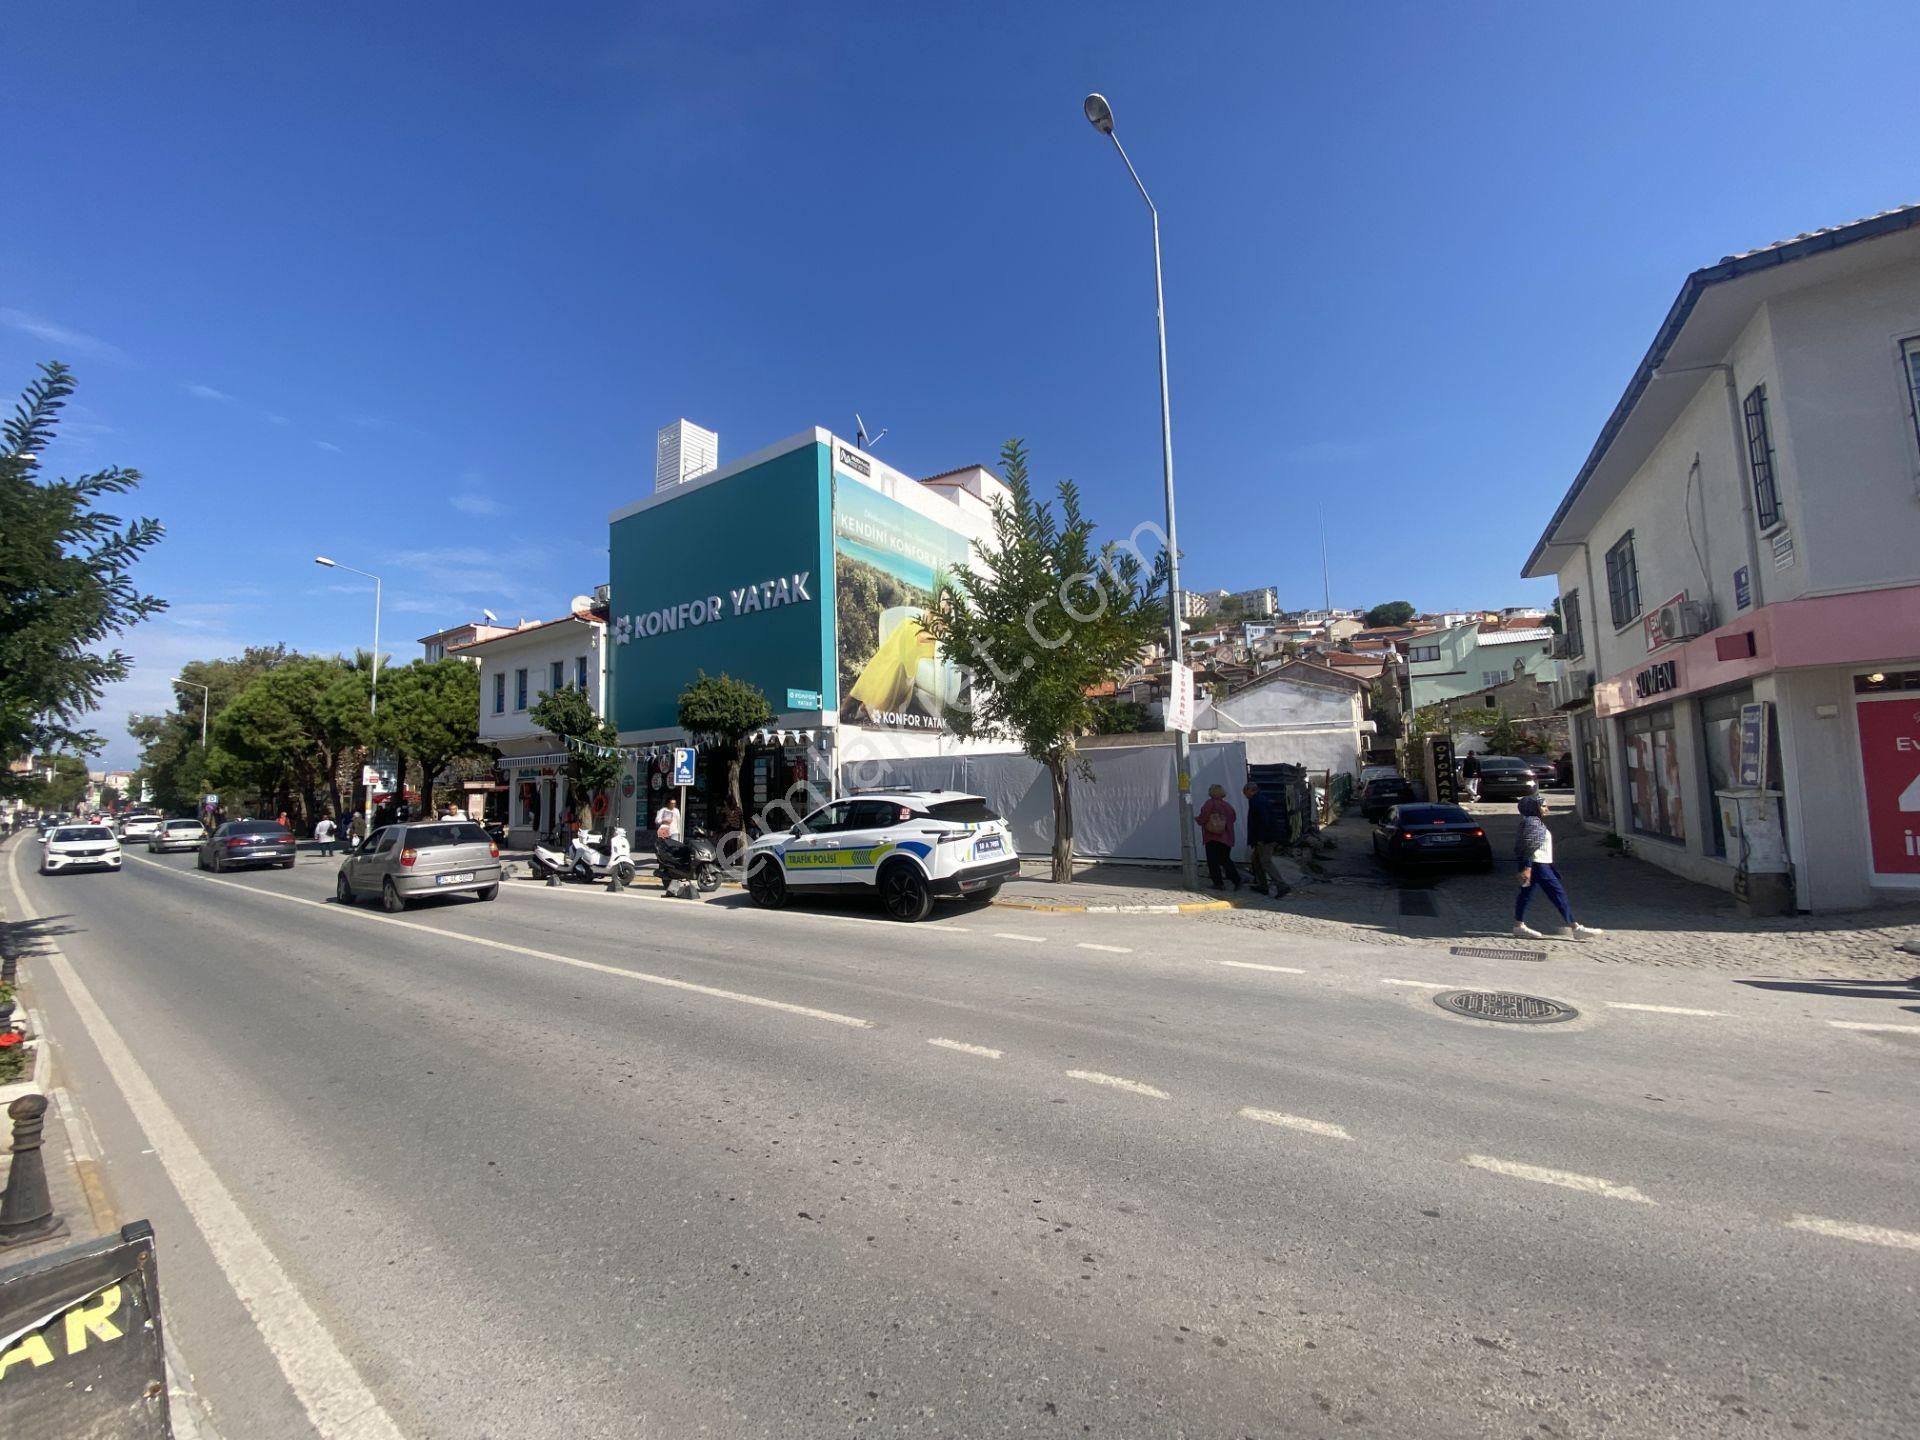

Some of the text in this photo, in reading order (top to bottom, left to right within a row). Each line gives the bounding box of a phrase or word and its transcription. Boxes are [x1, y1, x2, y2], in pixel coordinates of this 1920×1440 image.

[635, 571, 811, 639] KONFOR YATAK
[883, 711, 920, 727] KONFOR
[676, 750, 688, 768] P
[788, 852, 836, 864] TRAFİK POLİSİ
